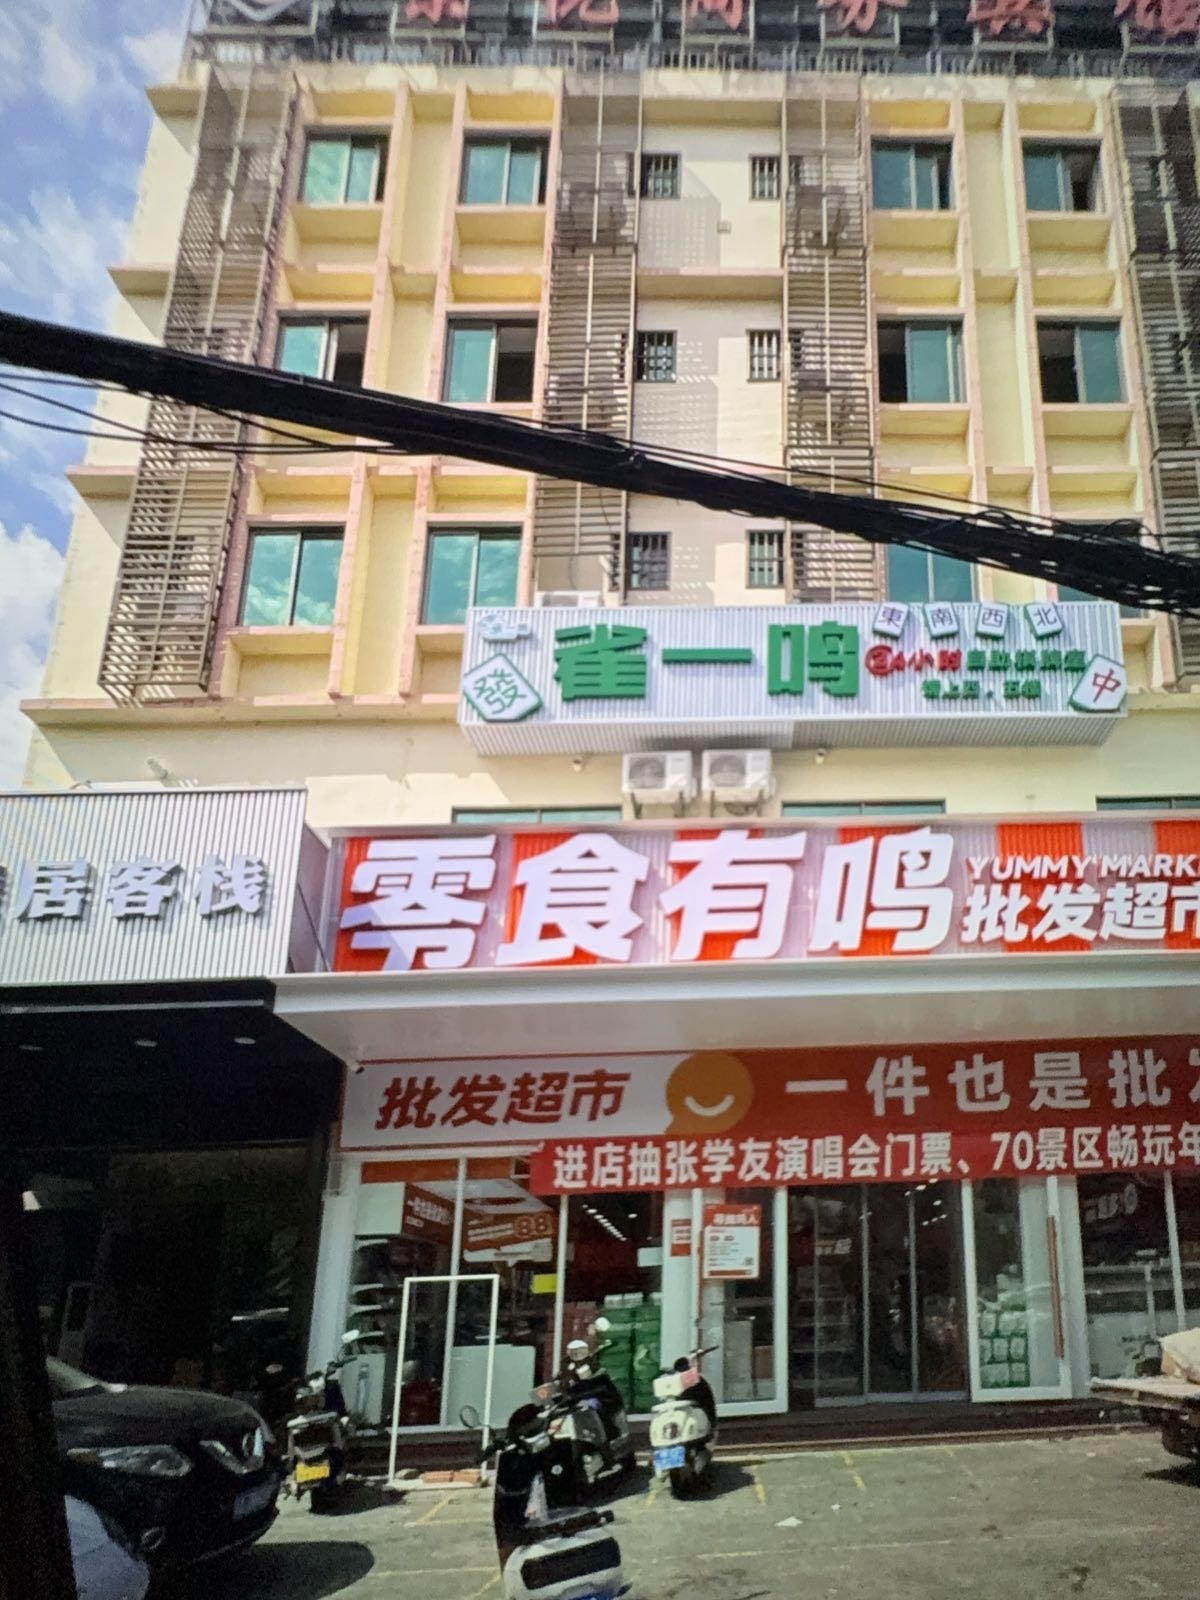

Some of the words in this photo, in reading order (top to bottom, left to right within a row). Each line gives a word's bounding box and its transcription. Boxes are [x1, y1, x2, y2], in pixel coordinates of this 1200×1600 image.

[1092, 668, 1121, 703] 中
[0, 854, 268, 922] 居客栈
[340, 828, 954, 970] 零食有鸣
[968, 855, 1095, 880] YUMMY
[1100, 853, 1200, 877] MARK
[374, 1068, 631, 1131] 批发超市
[785, 1048, 1200, 1118] 一件也是批
